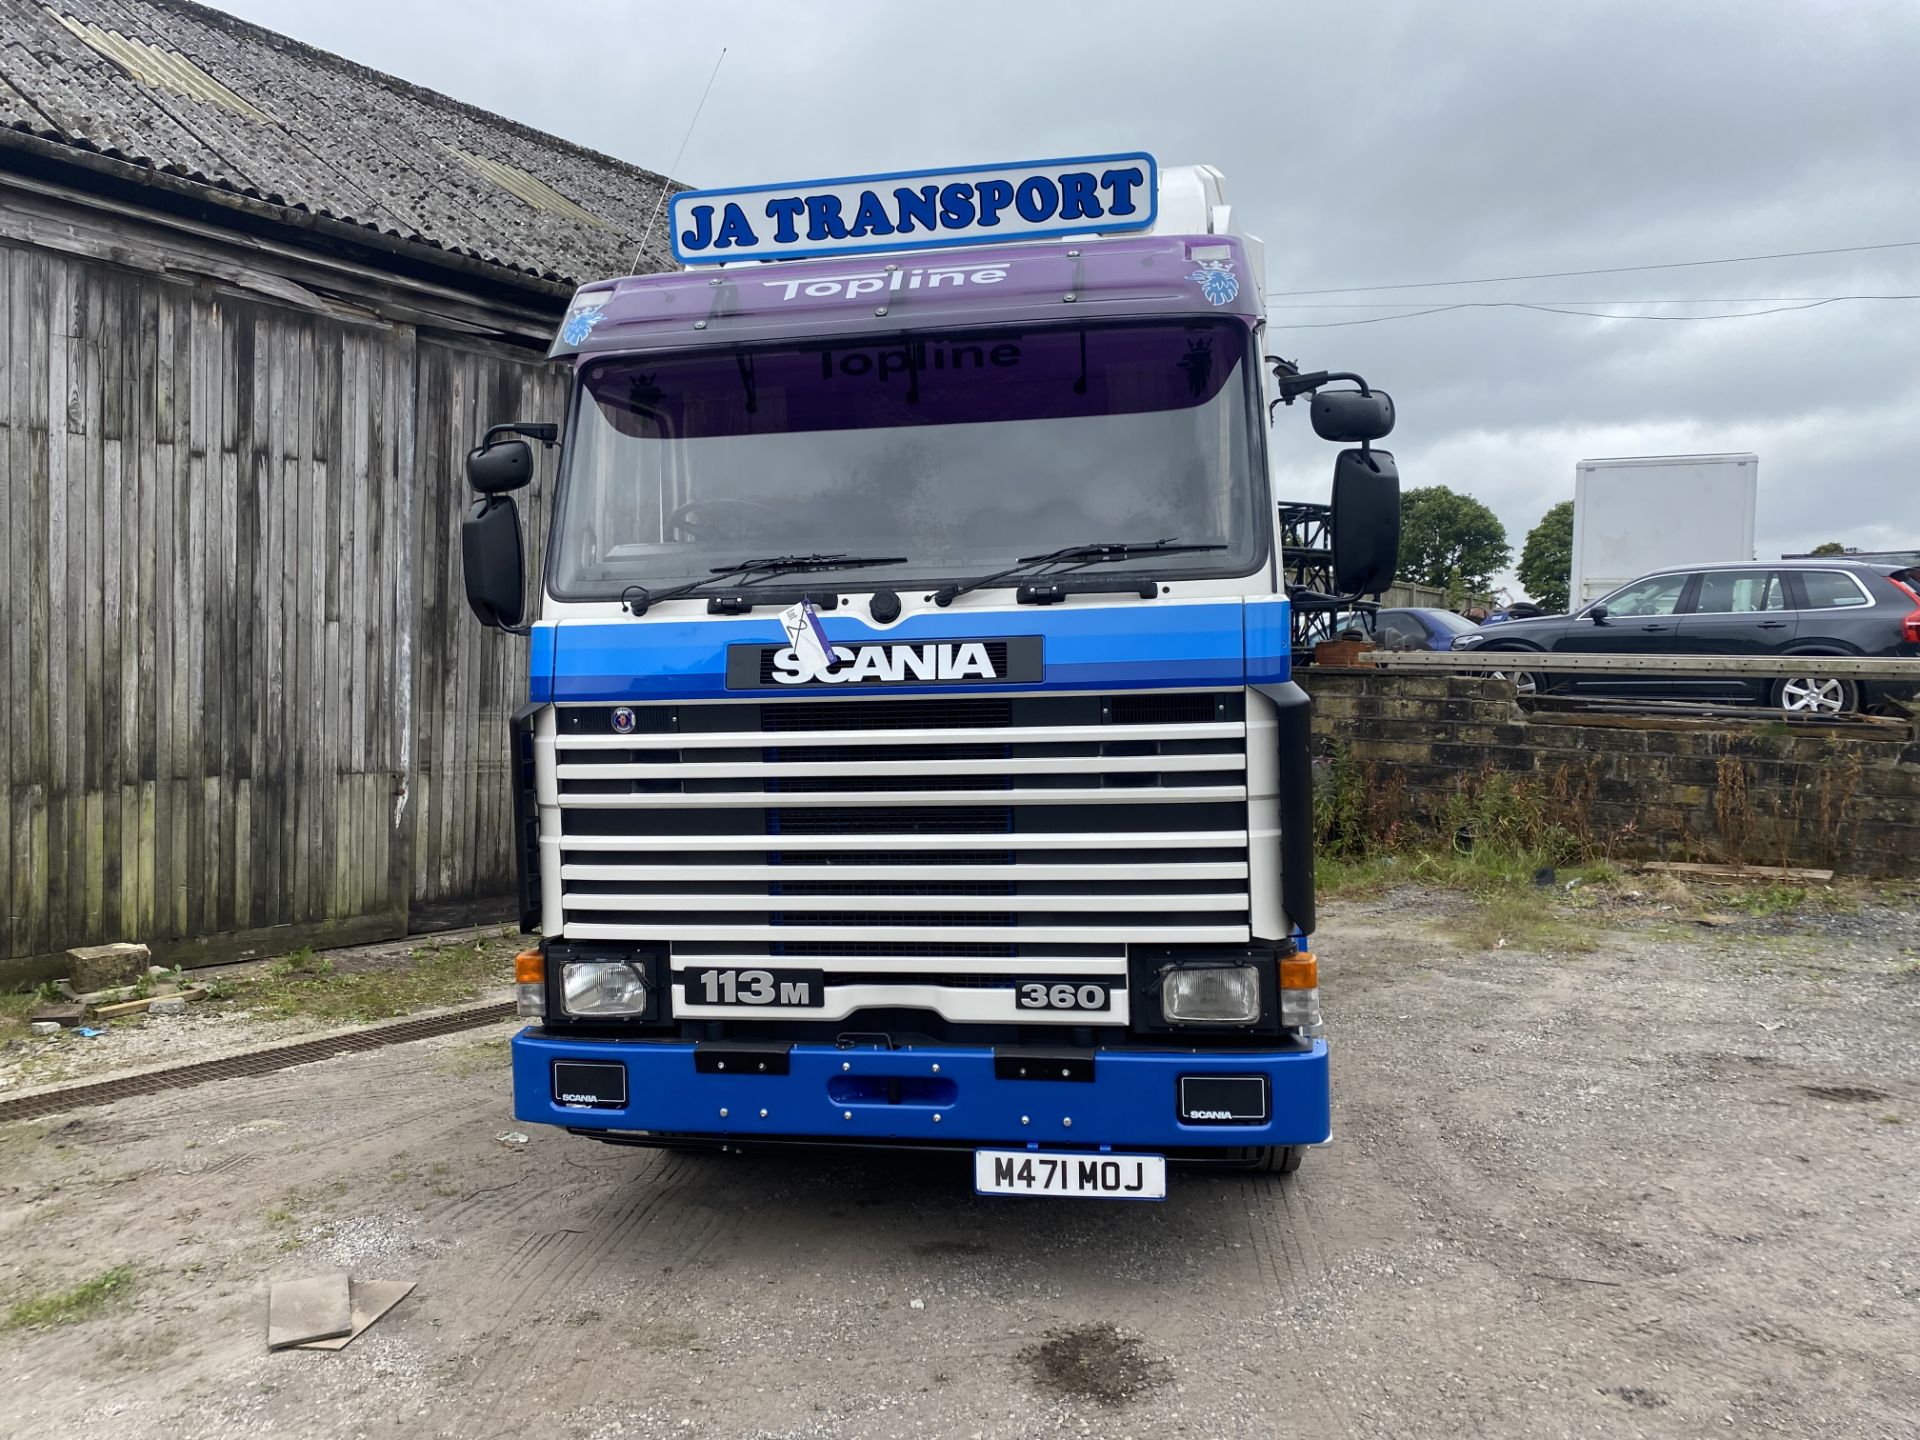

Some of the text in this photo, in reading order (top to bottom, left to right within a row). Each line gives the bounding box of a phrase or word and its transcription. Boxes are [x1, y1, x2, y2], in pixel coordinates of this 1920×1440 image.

[681, 167, 1144, 251] JA TRANSPORT
[763, 263, 1011, 301] Topline
[771, 642, 997, 684] SCANIA
[1020, 984, 1106, 1010] 360
[562, 1094, 598, 1103] SCANIA
[1189, 1109, 1233, 1120] SCANIA
[994, 1157, 1144, 1192] M471 MOJ
